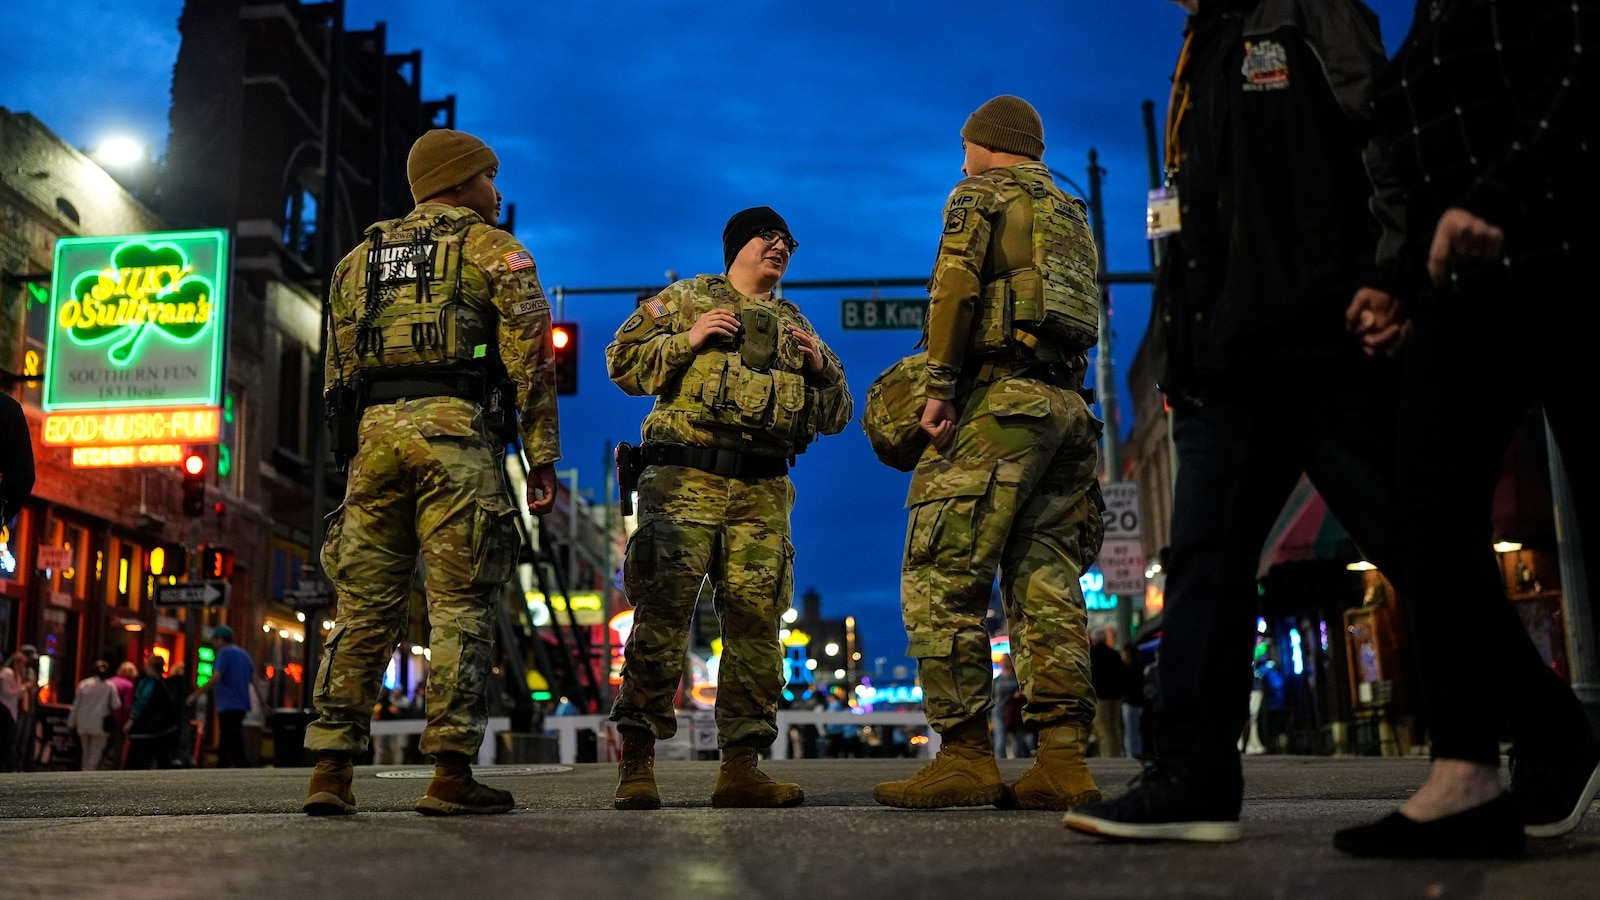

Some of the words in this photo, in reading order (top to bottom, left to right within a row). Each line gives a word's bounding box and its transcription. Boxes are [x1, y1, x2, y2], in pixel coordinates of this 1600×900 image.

[950, 196, 973, 208] MP
[369, 244, 433, 263] MILITY
[367, 259, 431, 281] OLIC
[91, 265, 191, 300] SILKY
[885, 303, 924, 328] King
[68, 366, 157, 384] SOUTHERN
[163, 365, 197, 380] FUN
[139, 444, 182, 463] OPEN
[1103, 488, 1137, 497] PEED
[1103, 510, 1137, 531] 20
